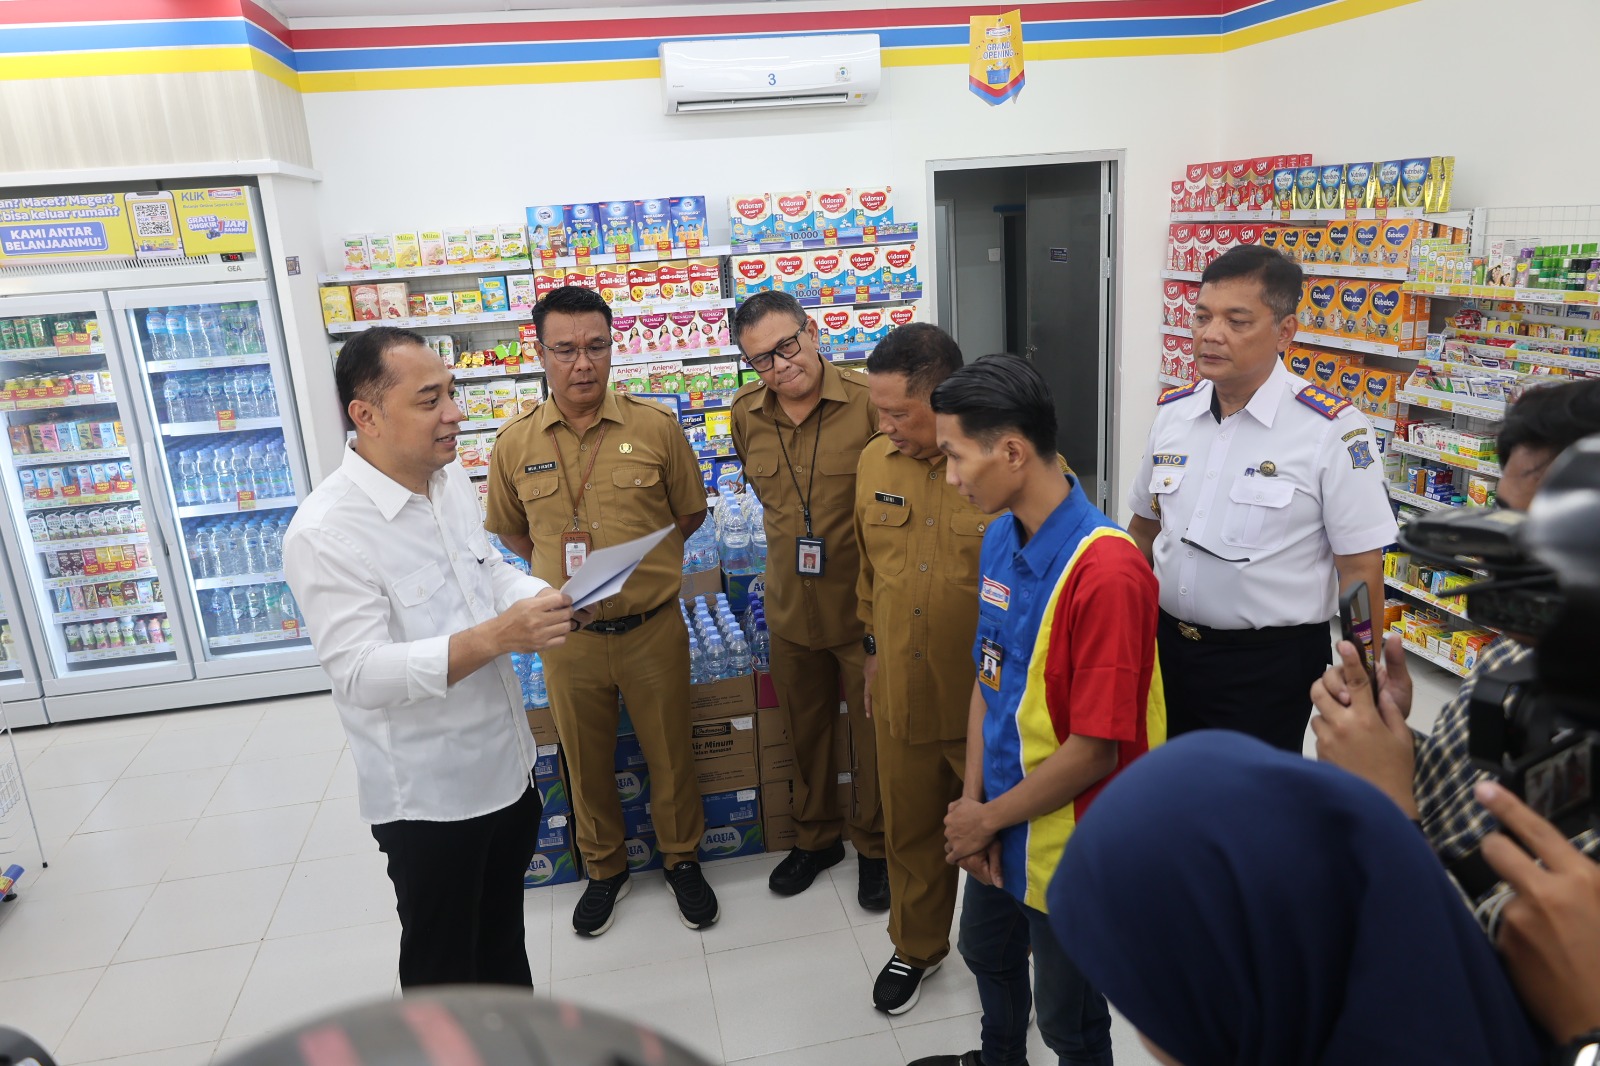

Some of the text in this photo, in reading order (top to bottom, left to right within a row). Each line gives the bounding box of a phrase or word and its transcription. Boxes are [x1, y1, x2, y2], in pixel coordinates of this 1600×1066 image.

[986, 42, 1011, 51] GRAND
[982, 50, 1014, 60] OPENING
[768, 73, 777, 86] 3
[1256, 161, 1268, 172] SGM
[22, 197, 66, 207] Macet?
[69, 193, 114, 207] Mager?
[820, 197, 845, 205] vidoran
[861, 195, 884, 203] vidoran
[738, 203, 763, 211] vidoran
[779, 200, 804, 208] vidoran
[3, 206, 119, 221] bisa keluar rumah?
[187, 216, 217, 224] GRATIS
[188, 221, 217, 230] ONGKIR
[218, 220, 246, 231] 1 JAM
[10, 226, 93, 240] KAMI ANTAR
[789, 231, 818, 240] 10.000
[1177, 228, 1188, 238] SGM
[1199, 228, 1210, 238] SGM
[1218, 228, 1230, 238] SGM
[1241, 229, 1254, 240] SGM
[1387, 231, 1405, 239] Bebelac
[5, 237, 102, 251] BELANJAANMU!
[887, 253, 909, 261] vidoran
[777, 259, 800, 267] vidoran
[815, 258, 836, 266] vidoran
[740, 263, 763, 271] vidoran
[1167, 285, 1178, 295] SGM
[1312, 291, 1331, 300] Bebelac
[1343, 294, 1362, 303] Bebelac
[1374, 298, 1395, 306] Bebelac
[672, 313, 695, 321] PRENAGEN
[825, 314, 846, 322] vidoran
[860, 314, 880, 322] vidoran
[612, 318, 635, 326] PRENAGEN
[1156, 455, 1182, 465] TRIO
[704, 738, 734, 749] Minum
[705, 832, 736, 845] AQUA
